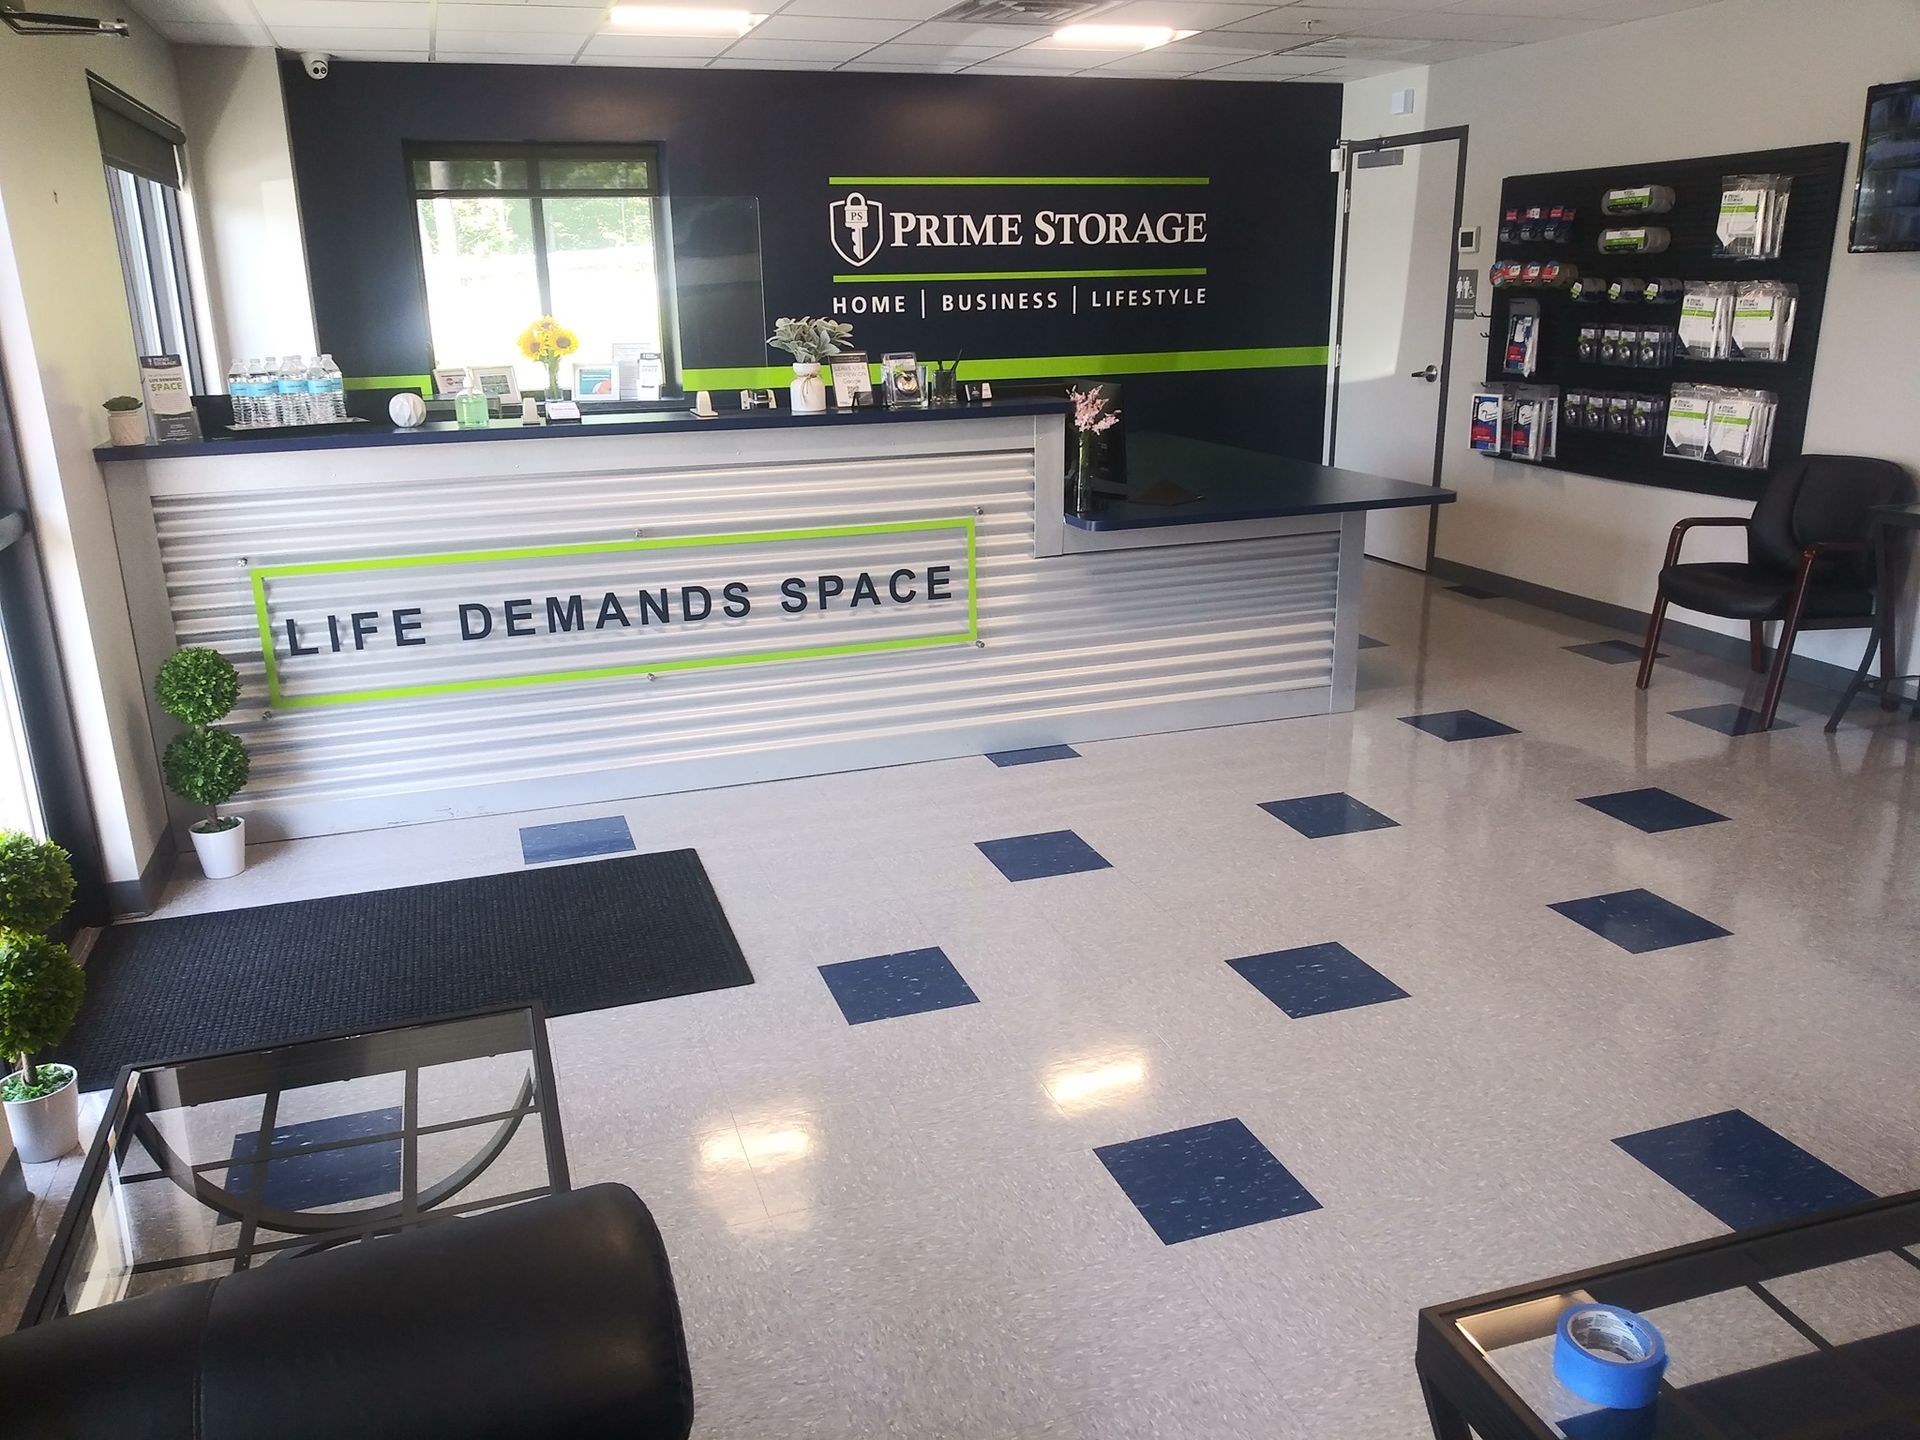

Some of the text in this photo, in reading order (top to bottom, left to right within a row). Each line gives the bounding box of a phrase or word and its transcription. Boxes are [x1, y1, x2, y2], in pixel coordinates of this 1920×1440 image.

[850, 211, 863, 221] PS
[889, 210, 1208, 247] PRIME STORAGE
[832, 288, 1207, 314] HOME BUSINESS LIFESTYLE
[151, 382, 183, 391] SPACE
[286, 565, 952, 657] LIFE DEMANDS SPACE
